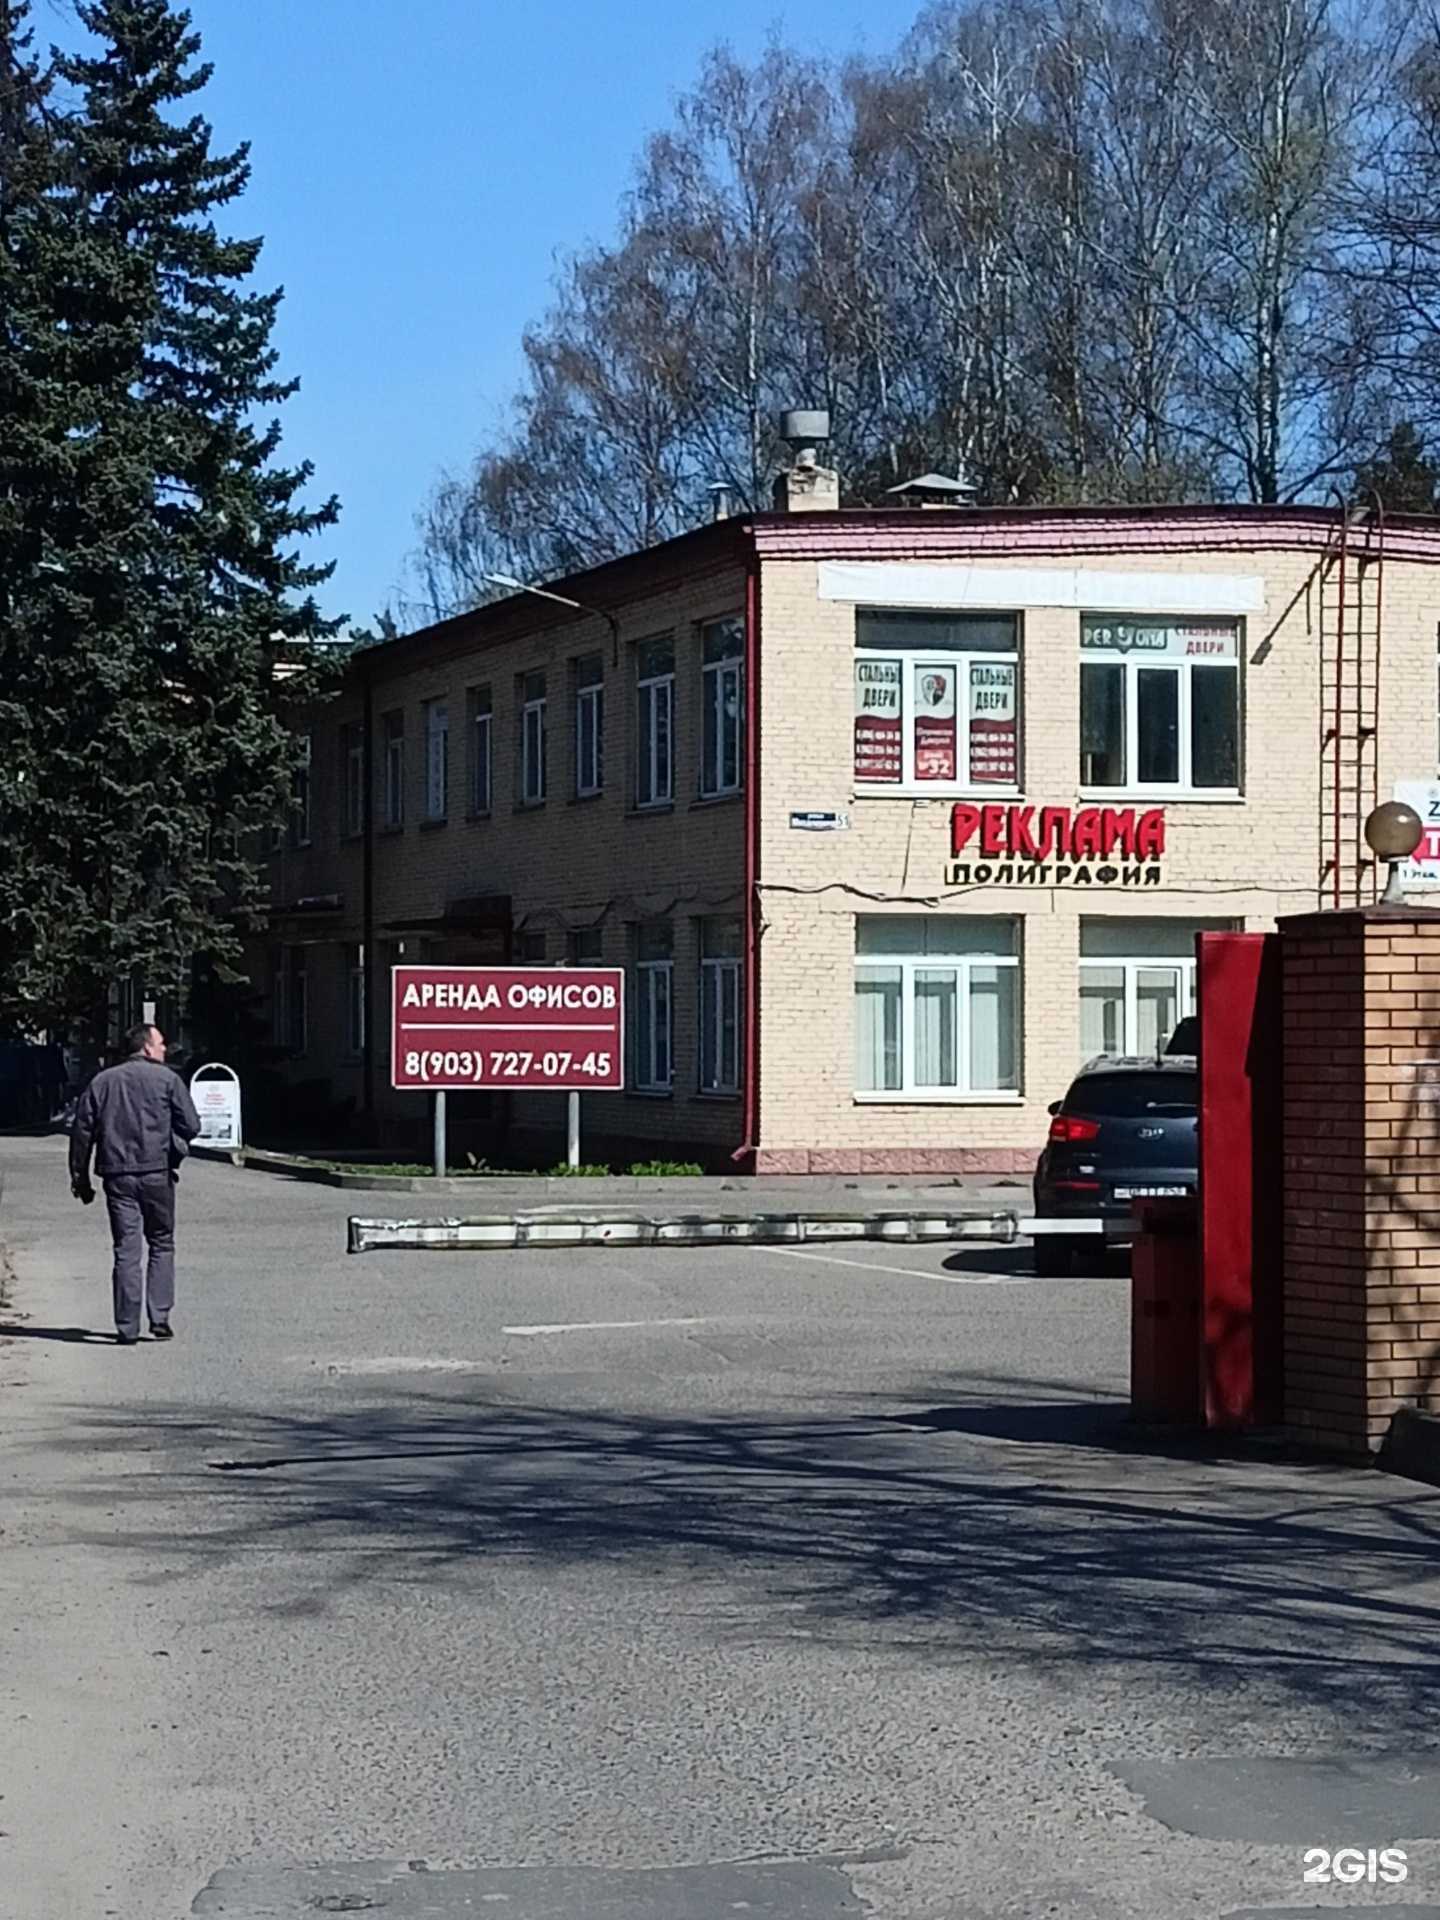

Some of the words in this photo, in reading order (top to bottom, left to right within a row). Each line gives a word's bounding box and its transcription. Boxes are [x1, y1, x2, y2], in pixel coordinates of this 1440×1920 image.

[1186, 641, 1224, 655] ДВЕРИ
[858, 664, 900, 683] СТАЛЬНЫ
[970, 668, 1013, 687] СТАЛЬНЫЕ
[862, 688, 896, 709] ДВЕРИ
[975, 691, 1008, 711] ДВЕРИ
[952, 803, 1165, 861] РЕКЛАМА
[951, 863, 1161, 886] ПОЛИГРАФИЯ
[402, 983, 502, 1011] АРЕНДА
[507, 984, 616, 1009] ОФИСОВ
[405, 1051, 482, 1081] 8(903)
[490, 1052, 611, 1077] 727-07-45
